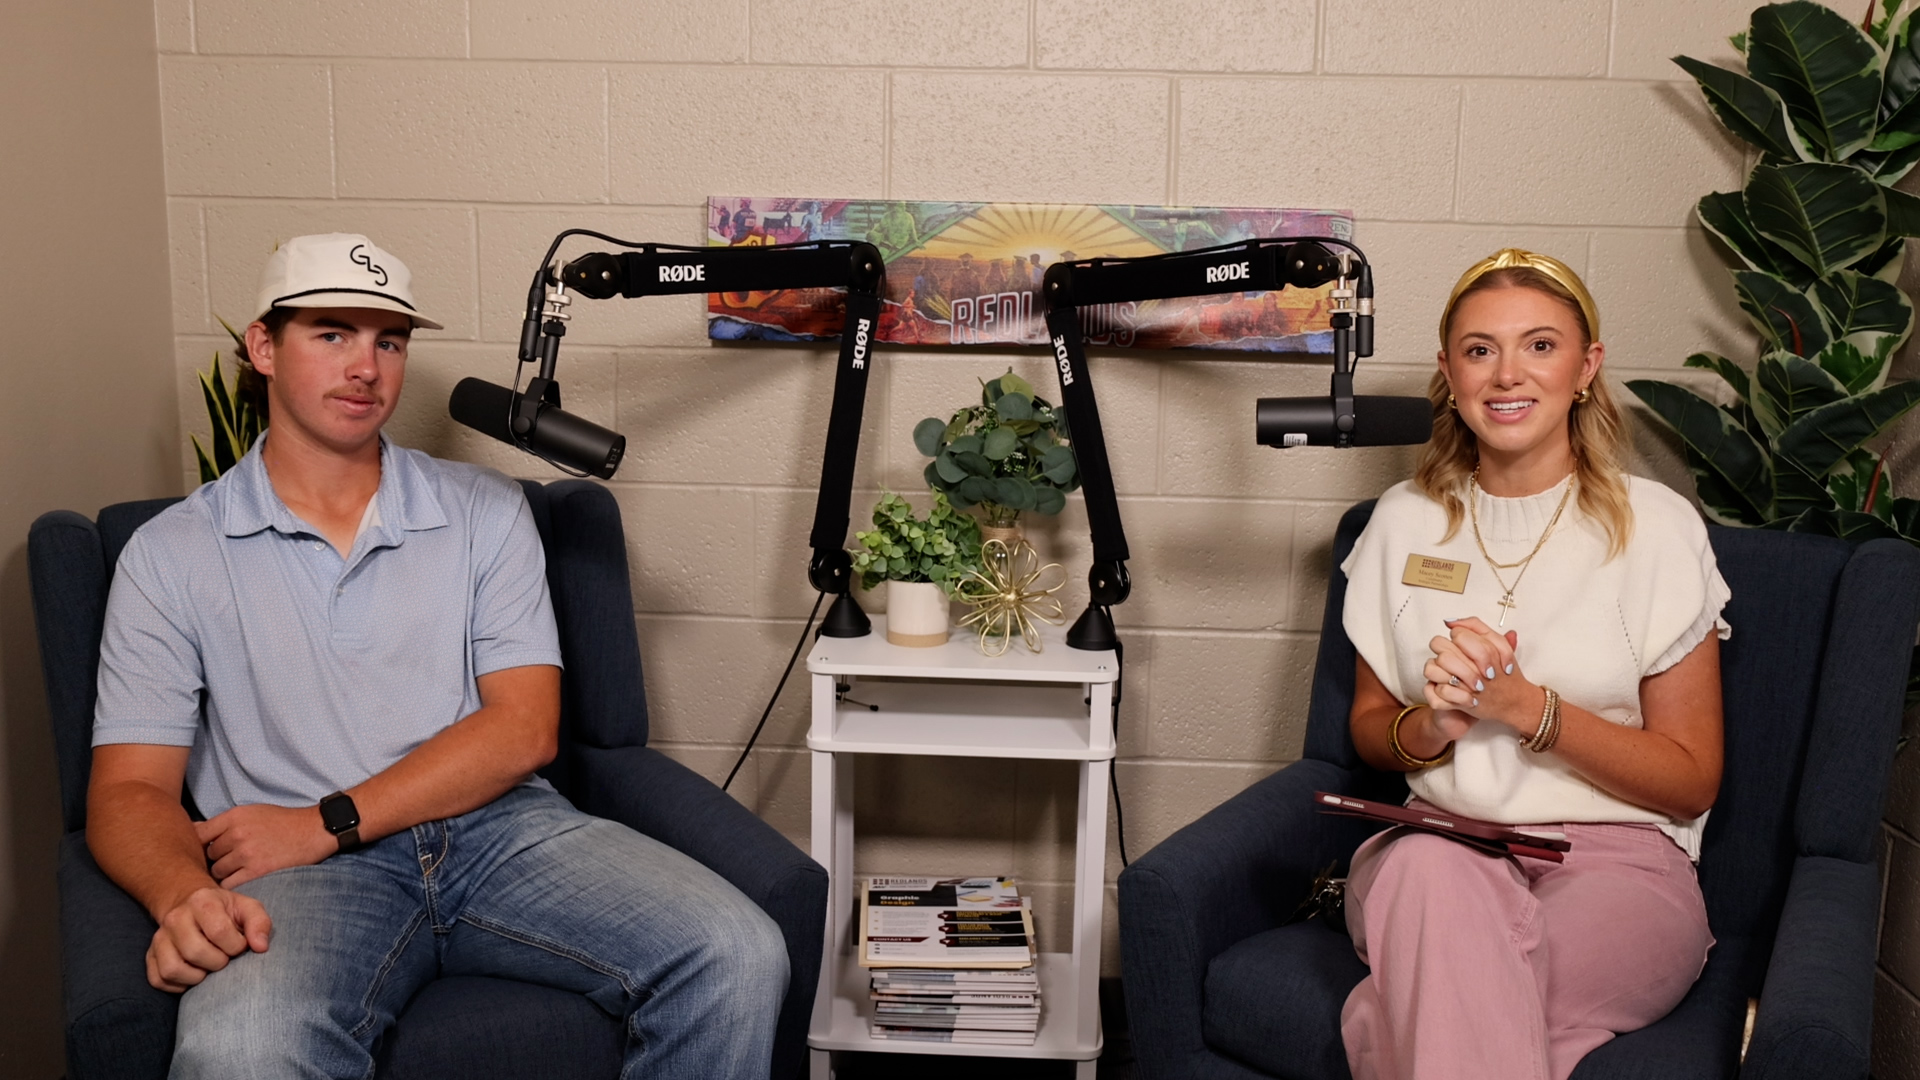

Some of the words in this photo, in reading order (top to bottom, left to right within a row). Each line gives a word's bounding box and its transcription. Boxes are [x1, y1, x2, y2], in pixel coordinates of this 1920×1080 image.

[659, 264, 706, 282] RØDE
[1206, 261, 1250, 283] RØDE
[852, 318, 871, 370] RØDE
[1053, 334, 1074, 386] RØDE
